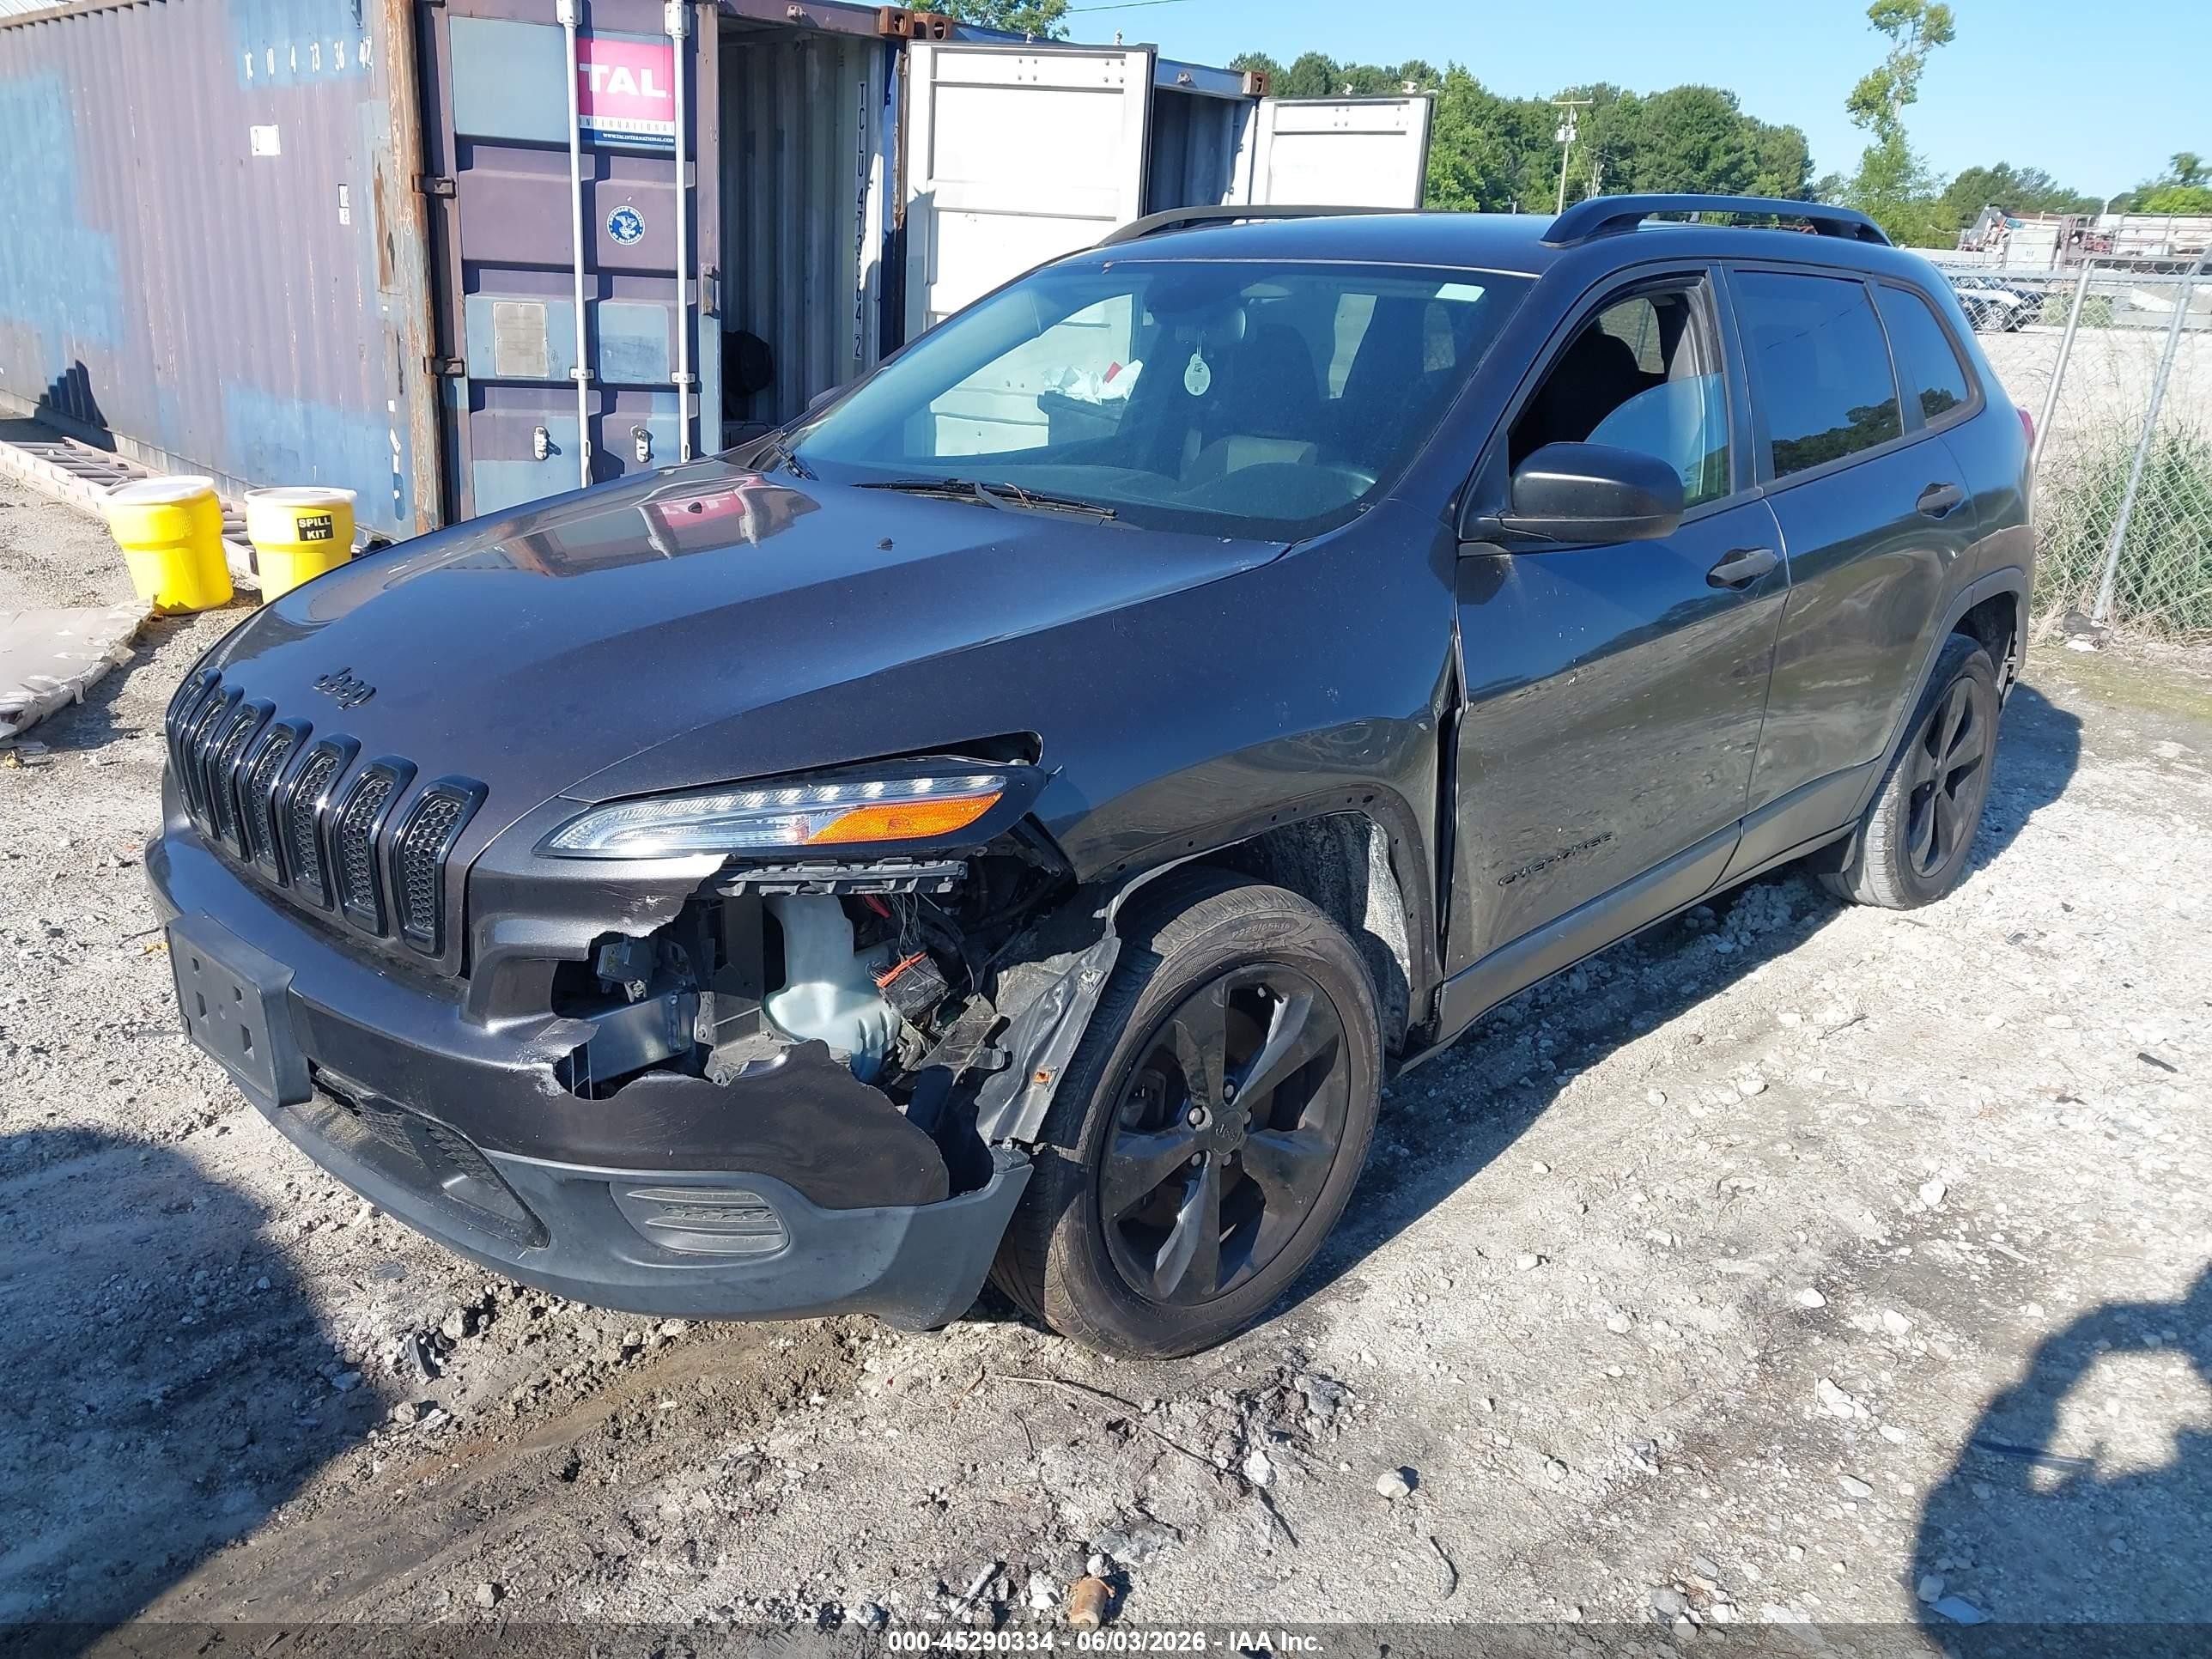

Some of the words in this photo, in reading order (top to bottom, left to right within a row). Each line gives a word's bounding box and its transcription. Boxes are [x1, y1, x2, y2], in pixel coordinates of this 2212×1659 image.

[579, 63, 667, 98] TAL
[580, 118, 674, 133] INTERNATIONAL
[298, 517, 331, 528] SPILL
[307, 529, 326, 540] KIT
